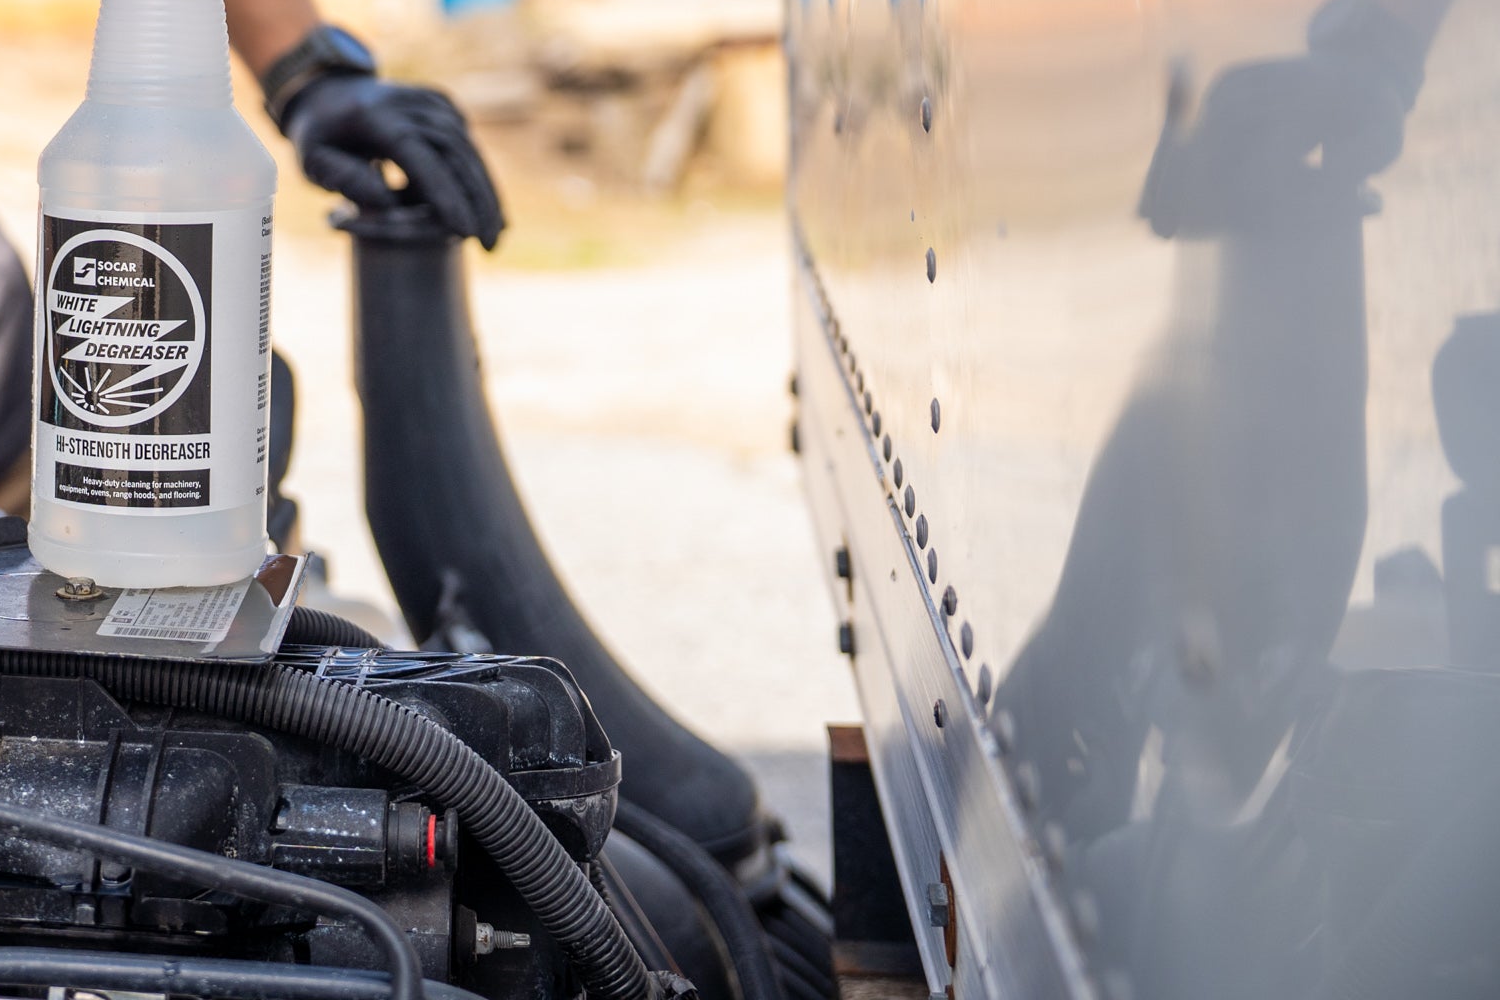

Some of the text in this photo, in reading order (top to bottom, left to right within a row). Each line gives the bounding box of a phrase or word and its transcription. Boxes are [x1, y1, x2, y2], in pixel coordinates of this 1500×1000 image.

[97, 261, 136, 272] SOCAR
[97, 276, 155, 287] CHEMICAL
[57, 294, 98, 312] WHITE
[68, 318, 161, 338] LIGHTNING
[84, 342, 189, 360] DEGREASER
[56, 434, 211, 460] HI-STRENGTH DEGREASER
[82, 476, 120, 488] Heavy-duty
[121, 480, 150, 489] cleaning
[152, 480, 162, 488] for
[59, 484, 202, 500] equipment, ovens, range hoods, and flooring.
